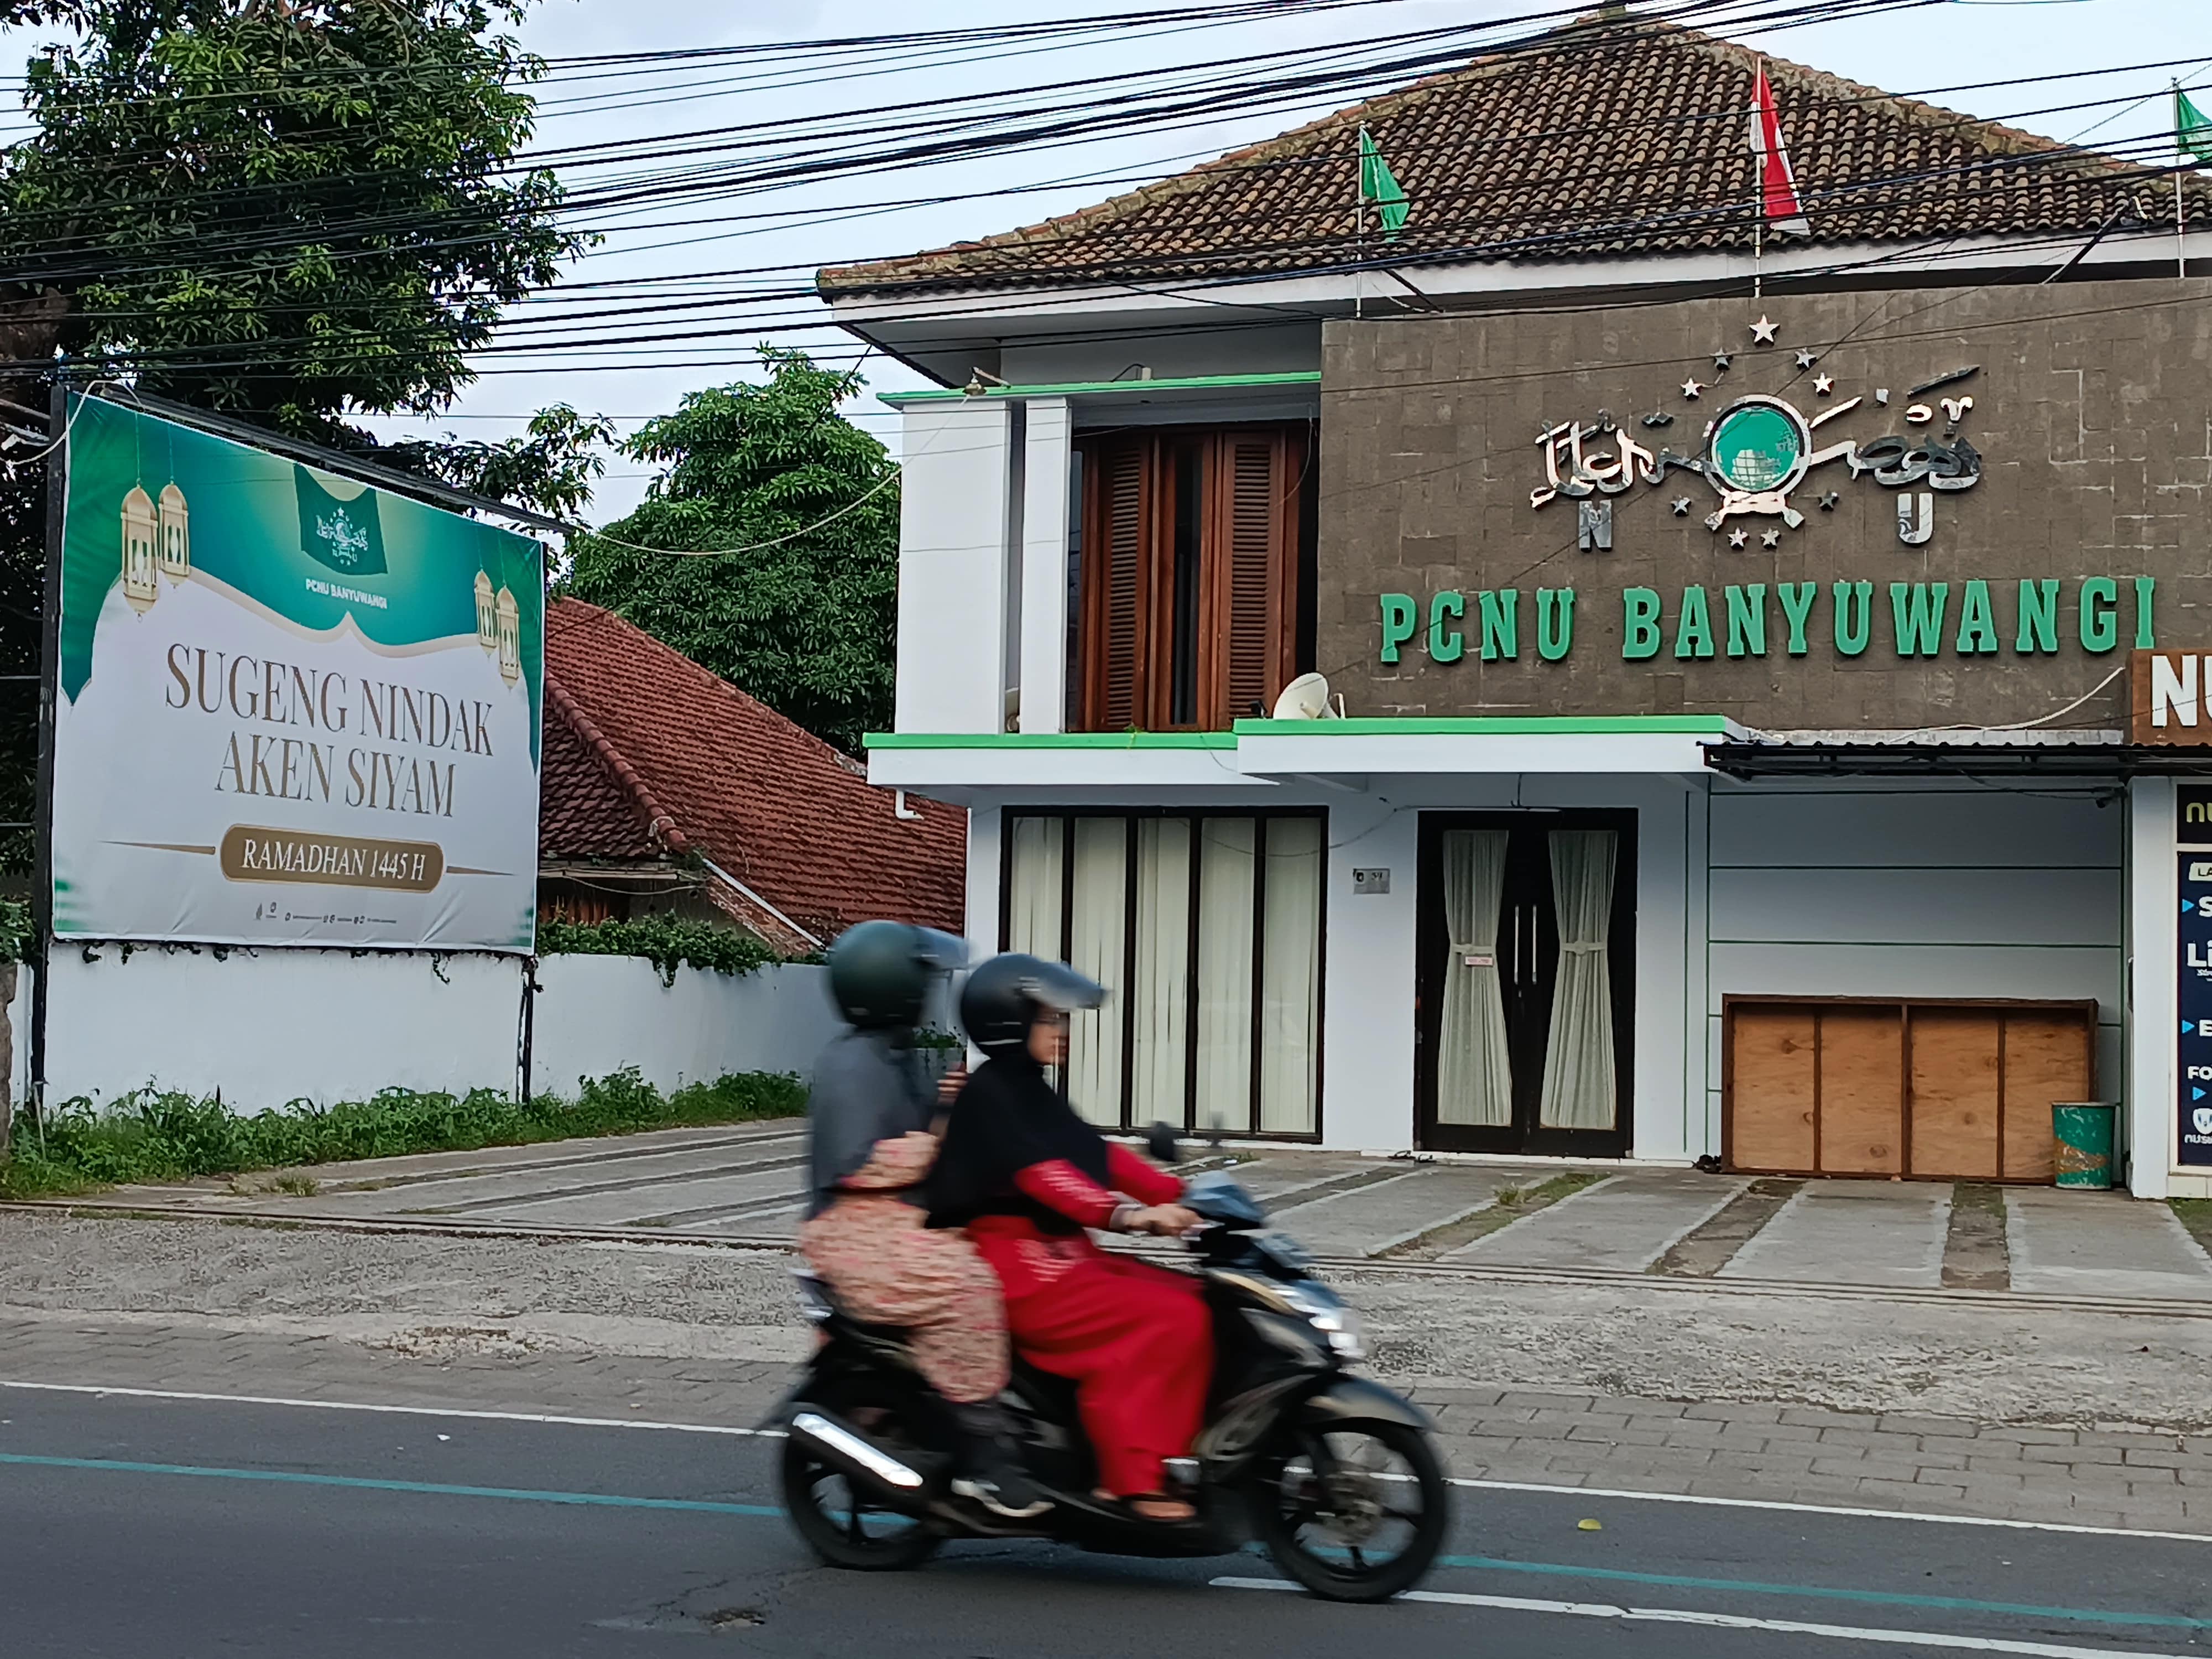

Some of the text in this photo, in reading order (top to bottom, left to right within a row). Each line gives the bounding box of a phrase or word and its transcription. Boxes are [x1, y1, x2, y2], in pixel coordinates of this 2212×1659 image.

[1579, 492, 1936, 552] N U
[305, 578, 388, 609] PCNU BANYUWANGI
[1380, 576, 2155, 665] PCNU BANYUWANGI
[166, 643, 494, 757] SUGENG NINDAK
[214, 731, 456, 818] AKEN SIYAM
[239, 838, 426, 881] RAMADHAN 1445 H
